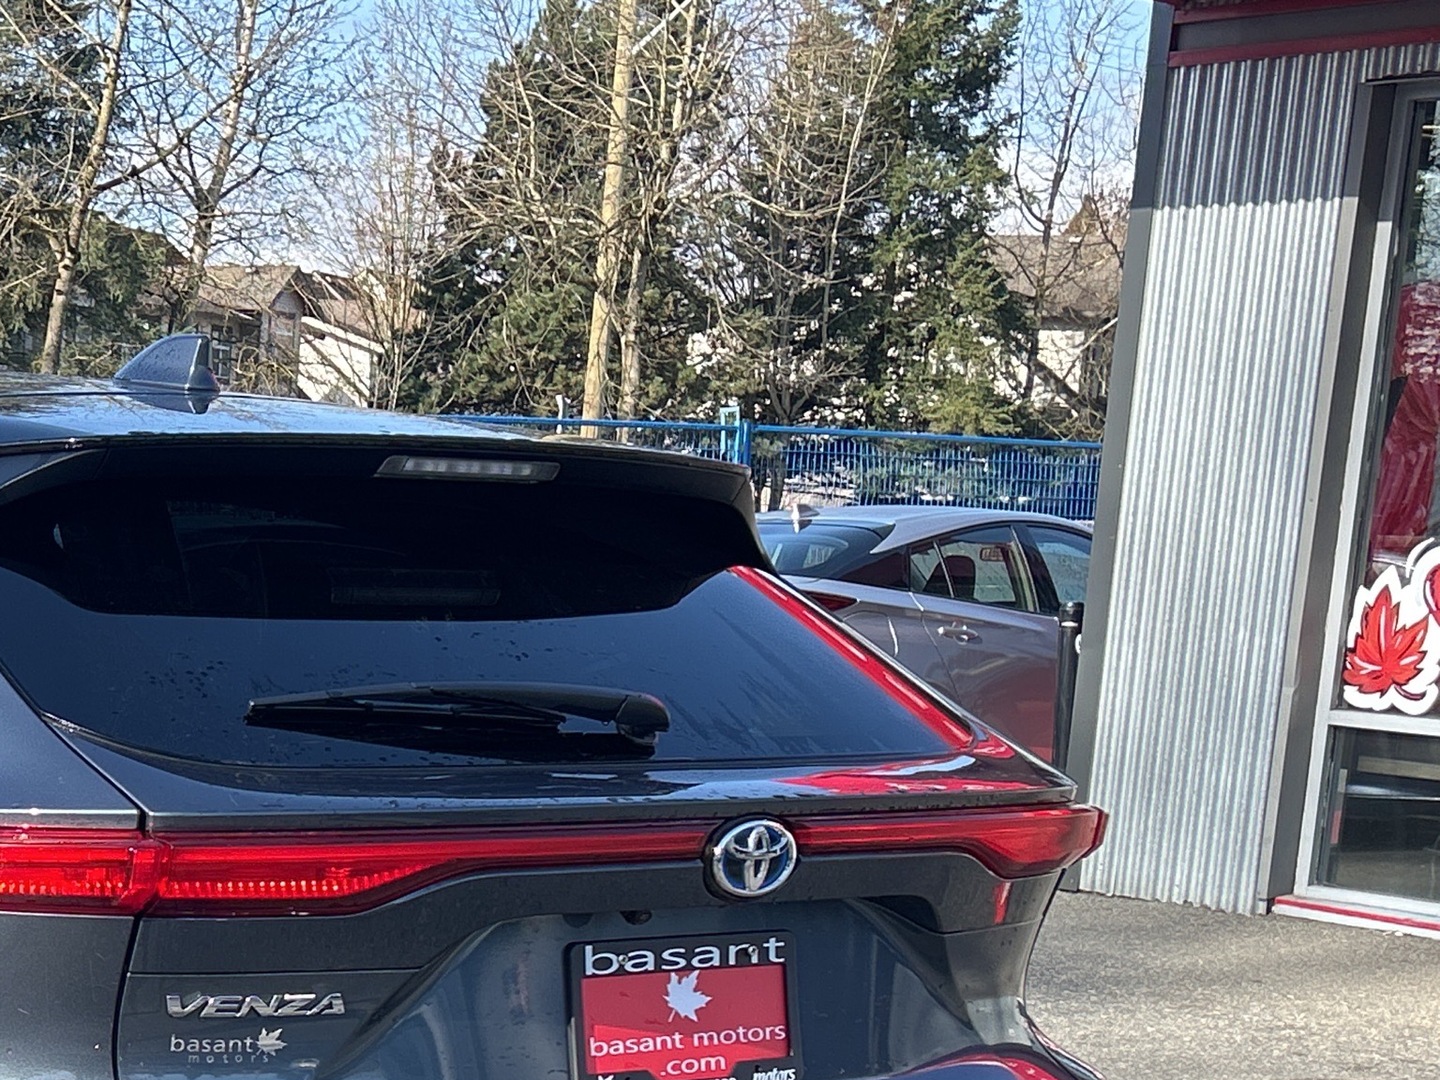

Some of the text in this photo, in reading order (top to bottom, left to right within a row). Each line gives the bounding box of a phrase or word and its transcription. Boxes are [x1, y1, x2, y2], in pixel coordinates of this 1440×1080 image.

[584, 937, 786, 976] basant
[165, 992, 346, 1018] VENZA
[169, 1033, 254, 1053] basant
[589, 1024, 787, 1057] basant motors
[187, 1054, 270, 1064] motors
[659, 1054, 727, 1077] .com
